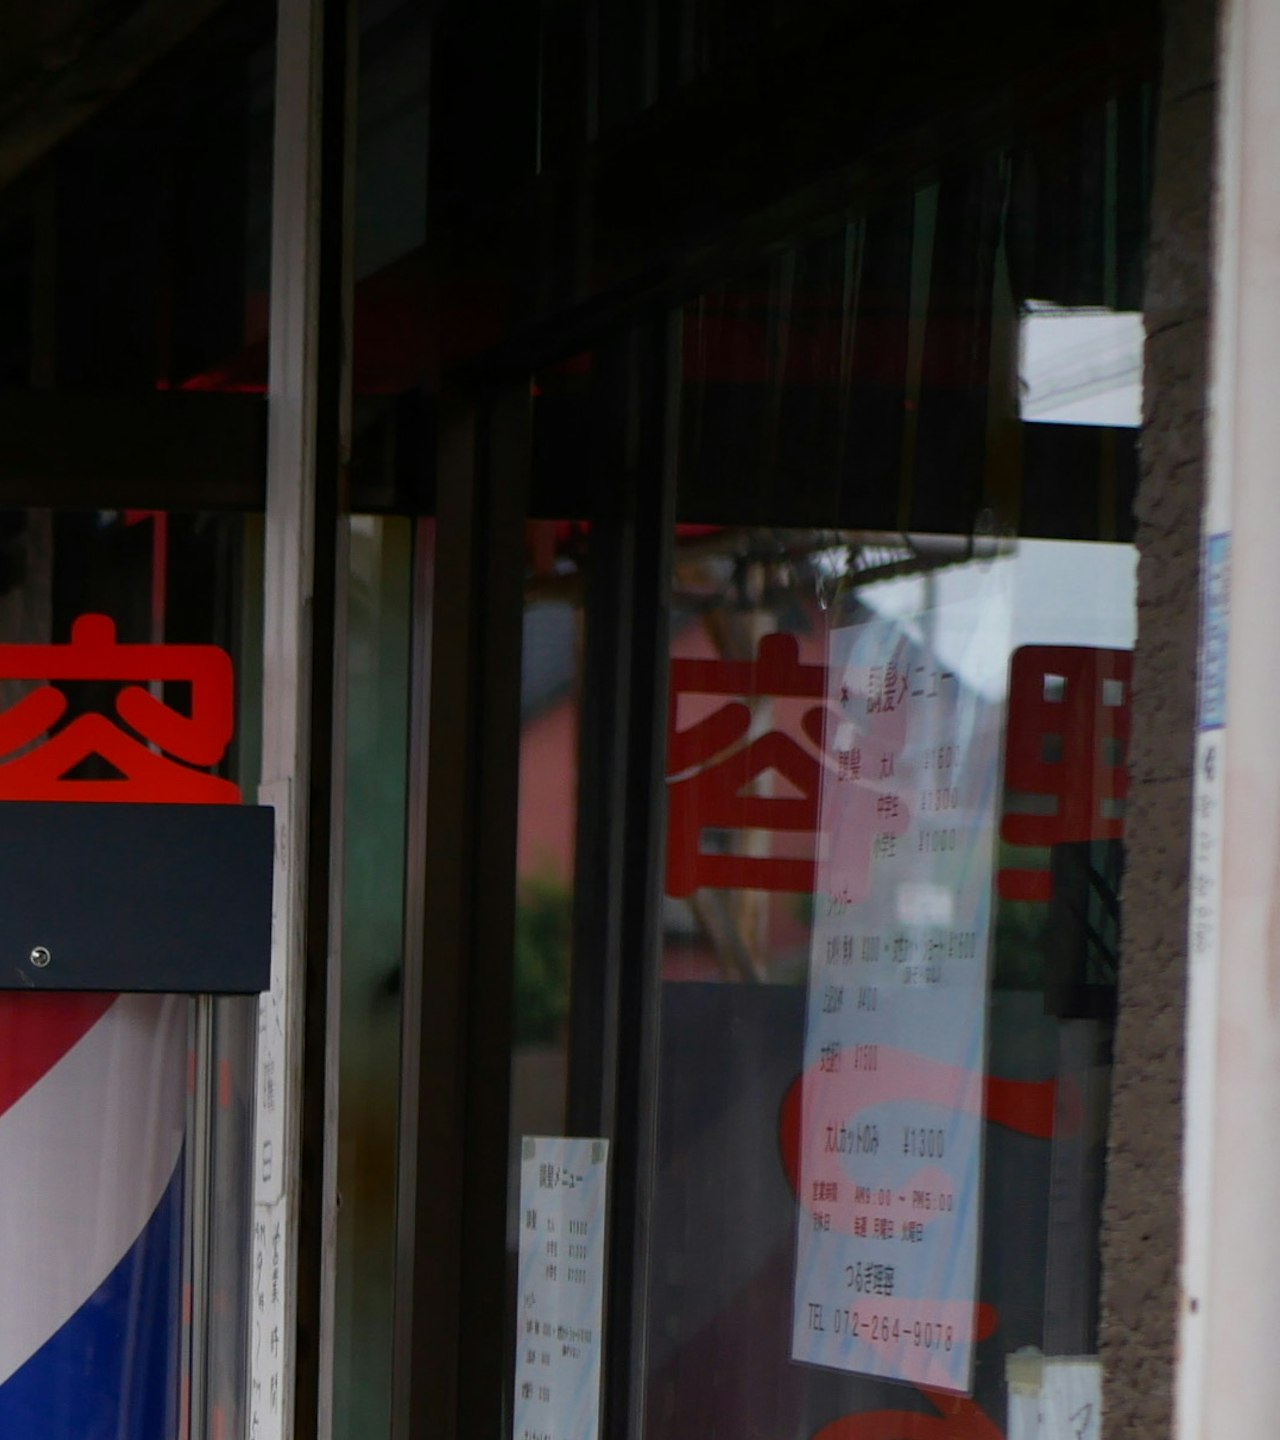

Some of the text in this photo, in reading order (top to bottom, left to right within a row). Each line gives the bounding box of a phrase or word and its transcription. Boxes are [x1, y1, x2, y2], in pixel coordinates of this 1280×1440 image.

[903, 1126, 945, 1158] ¥1300
[846, 1261, 894, 1296] つるぎ理容
[808, 1302, 953, 1351] TEL 072-264-9078
